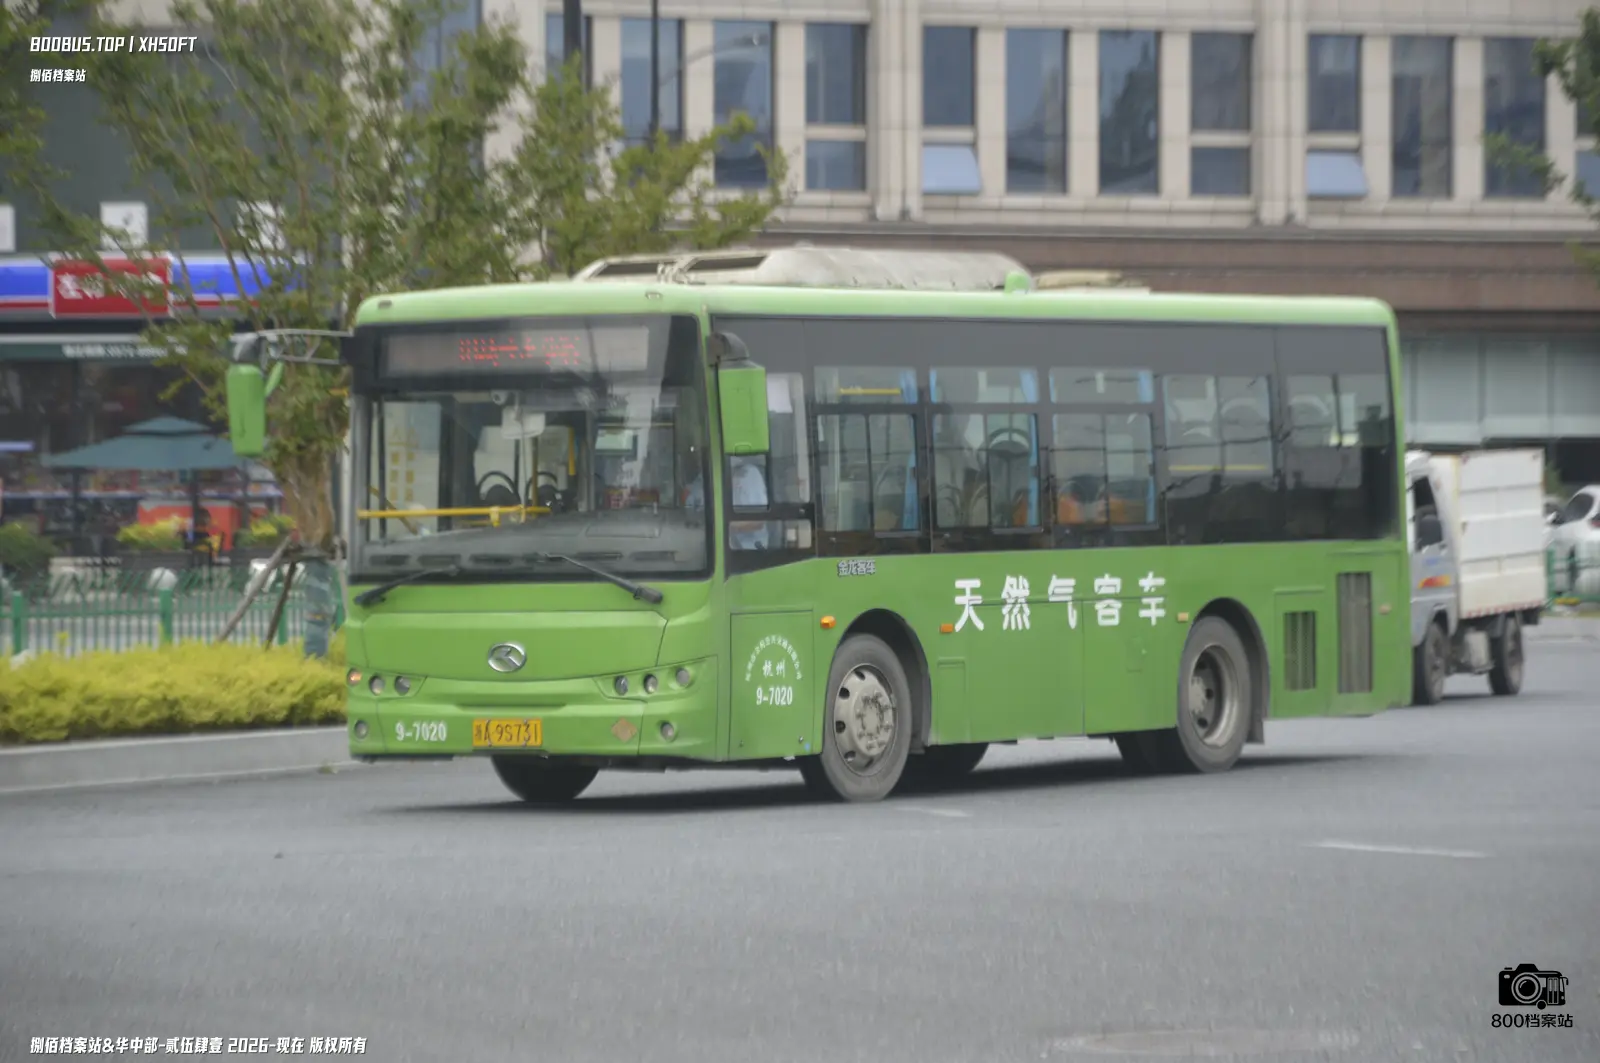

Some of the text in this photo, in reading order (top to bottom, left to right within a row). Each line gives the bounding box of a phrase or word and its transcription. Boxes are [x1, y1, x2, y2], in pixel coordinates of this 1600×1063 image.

[837, 559, 876, 576] 金龙客车
[953, 571, 1167, 633] 天然气客车
[756, 685, 793, 706] 9-7020
[395, 721, 447, 742] 9-7020
